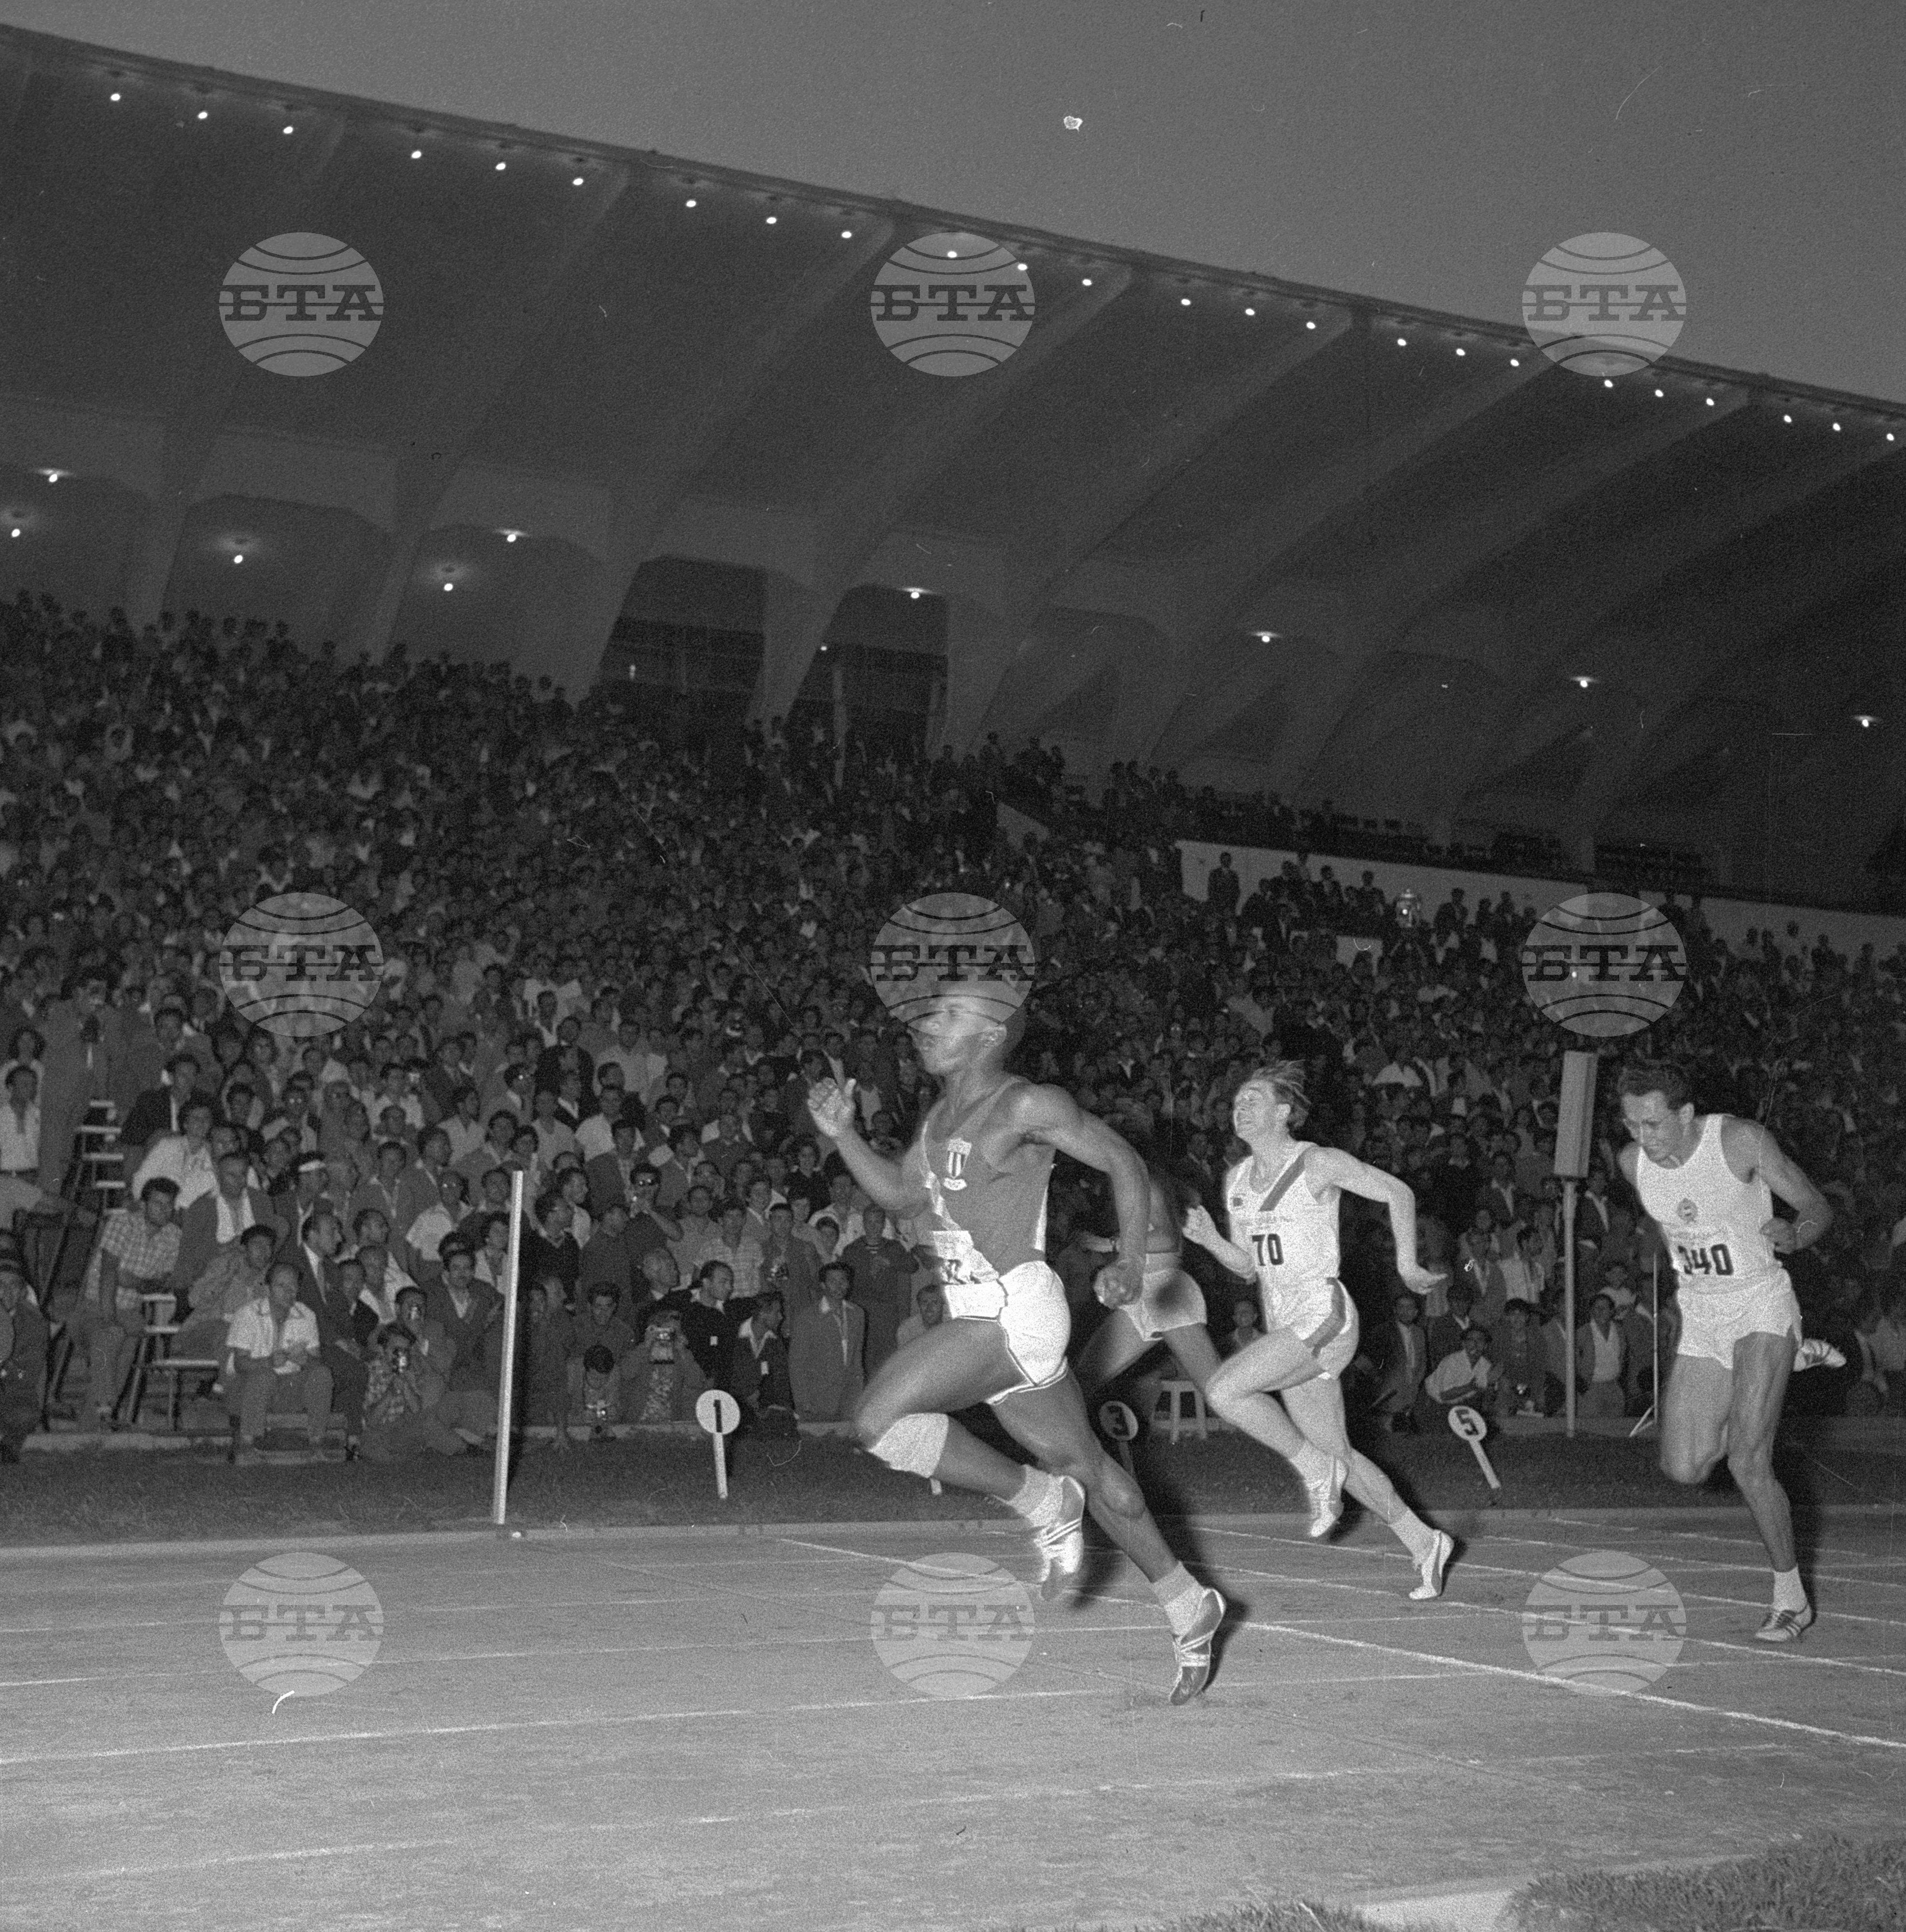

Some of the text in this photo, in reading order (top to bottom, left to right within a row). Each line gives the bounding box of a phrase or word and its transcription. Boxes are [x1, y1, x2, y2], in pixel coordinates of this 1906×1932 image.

[1252, 1234, 1284, 1266] 70
[713, 1400, 722, 1433] 1
[1107, 1405, 1129, 1436] 3
[1454, 1409, 1479, 1435] 5
